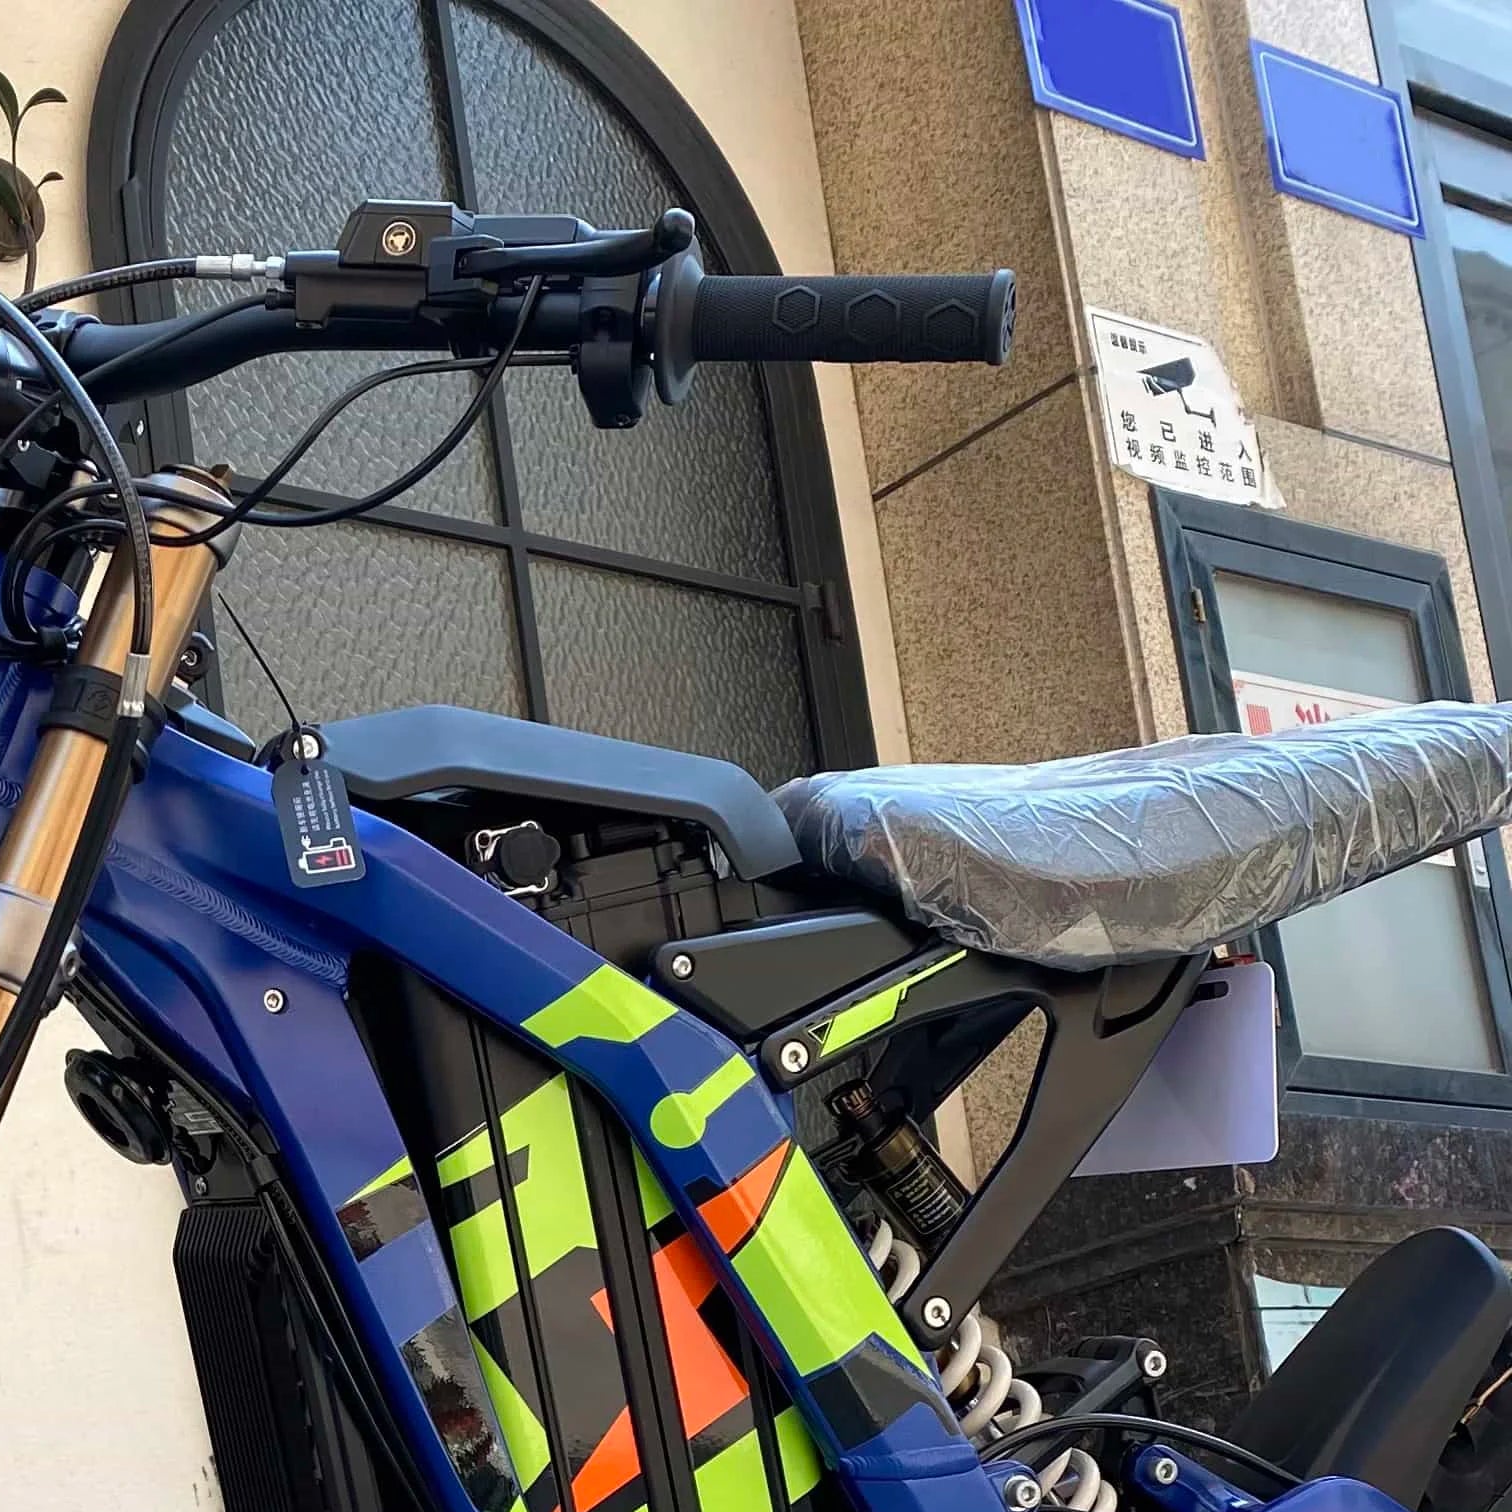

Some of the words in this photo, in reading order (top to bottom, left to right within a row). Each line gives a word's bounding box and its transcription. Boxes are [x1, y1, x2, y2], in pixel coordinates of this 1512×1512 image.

[1120, 409, 1253, 463] 您已进入
[1126, 437, 1258, 489] 视频监控范围
